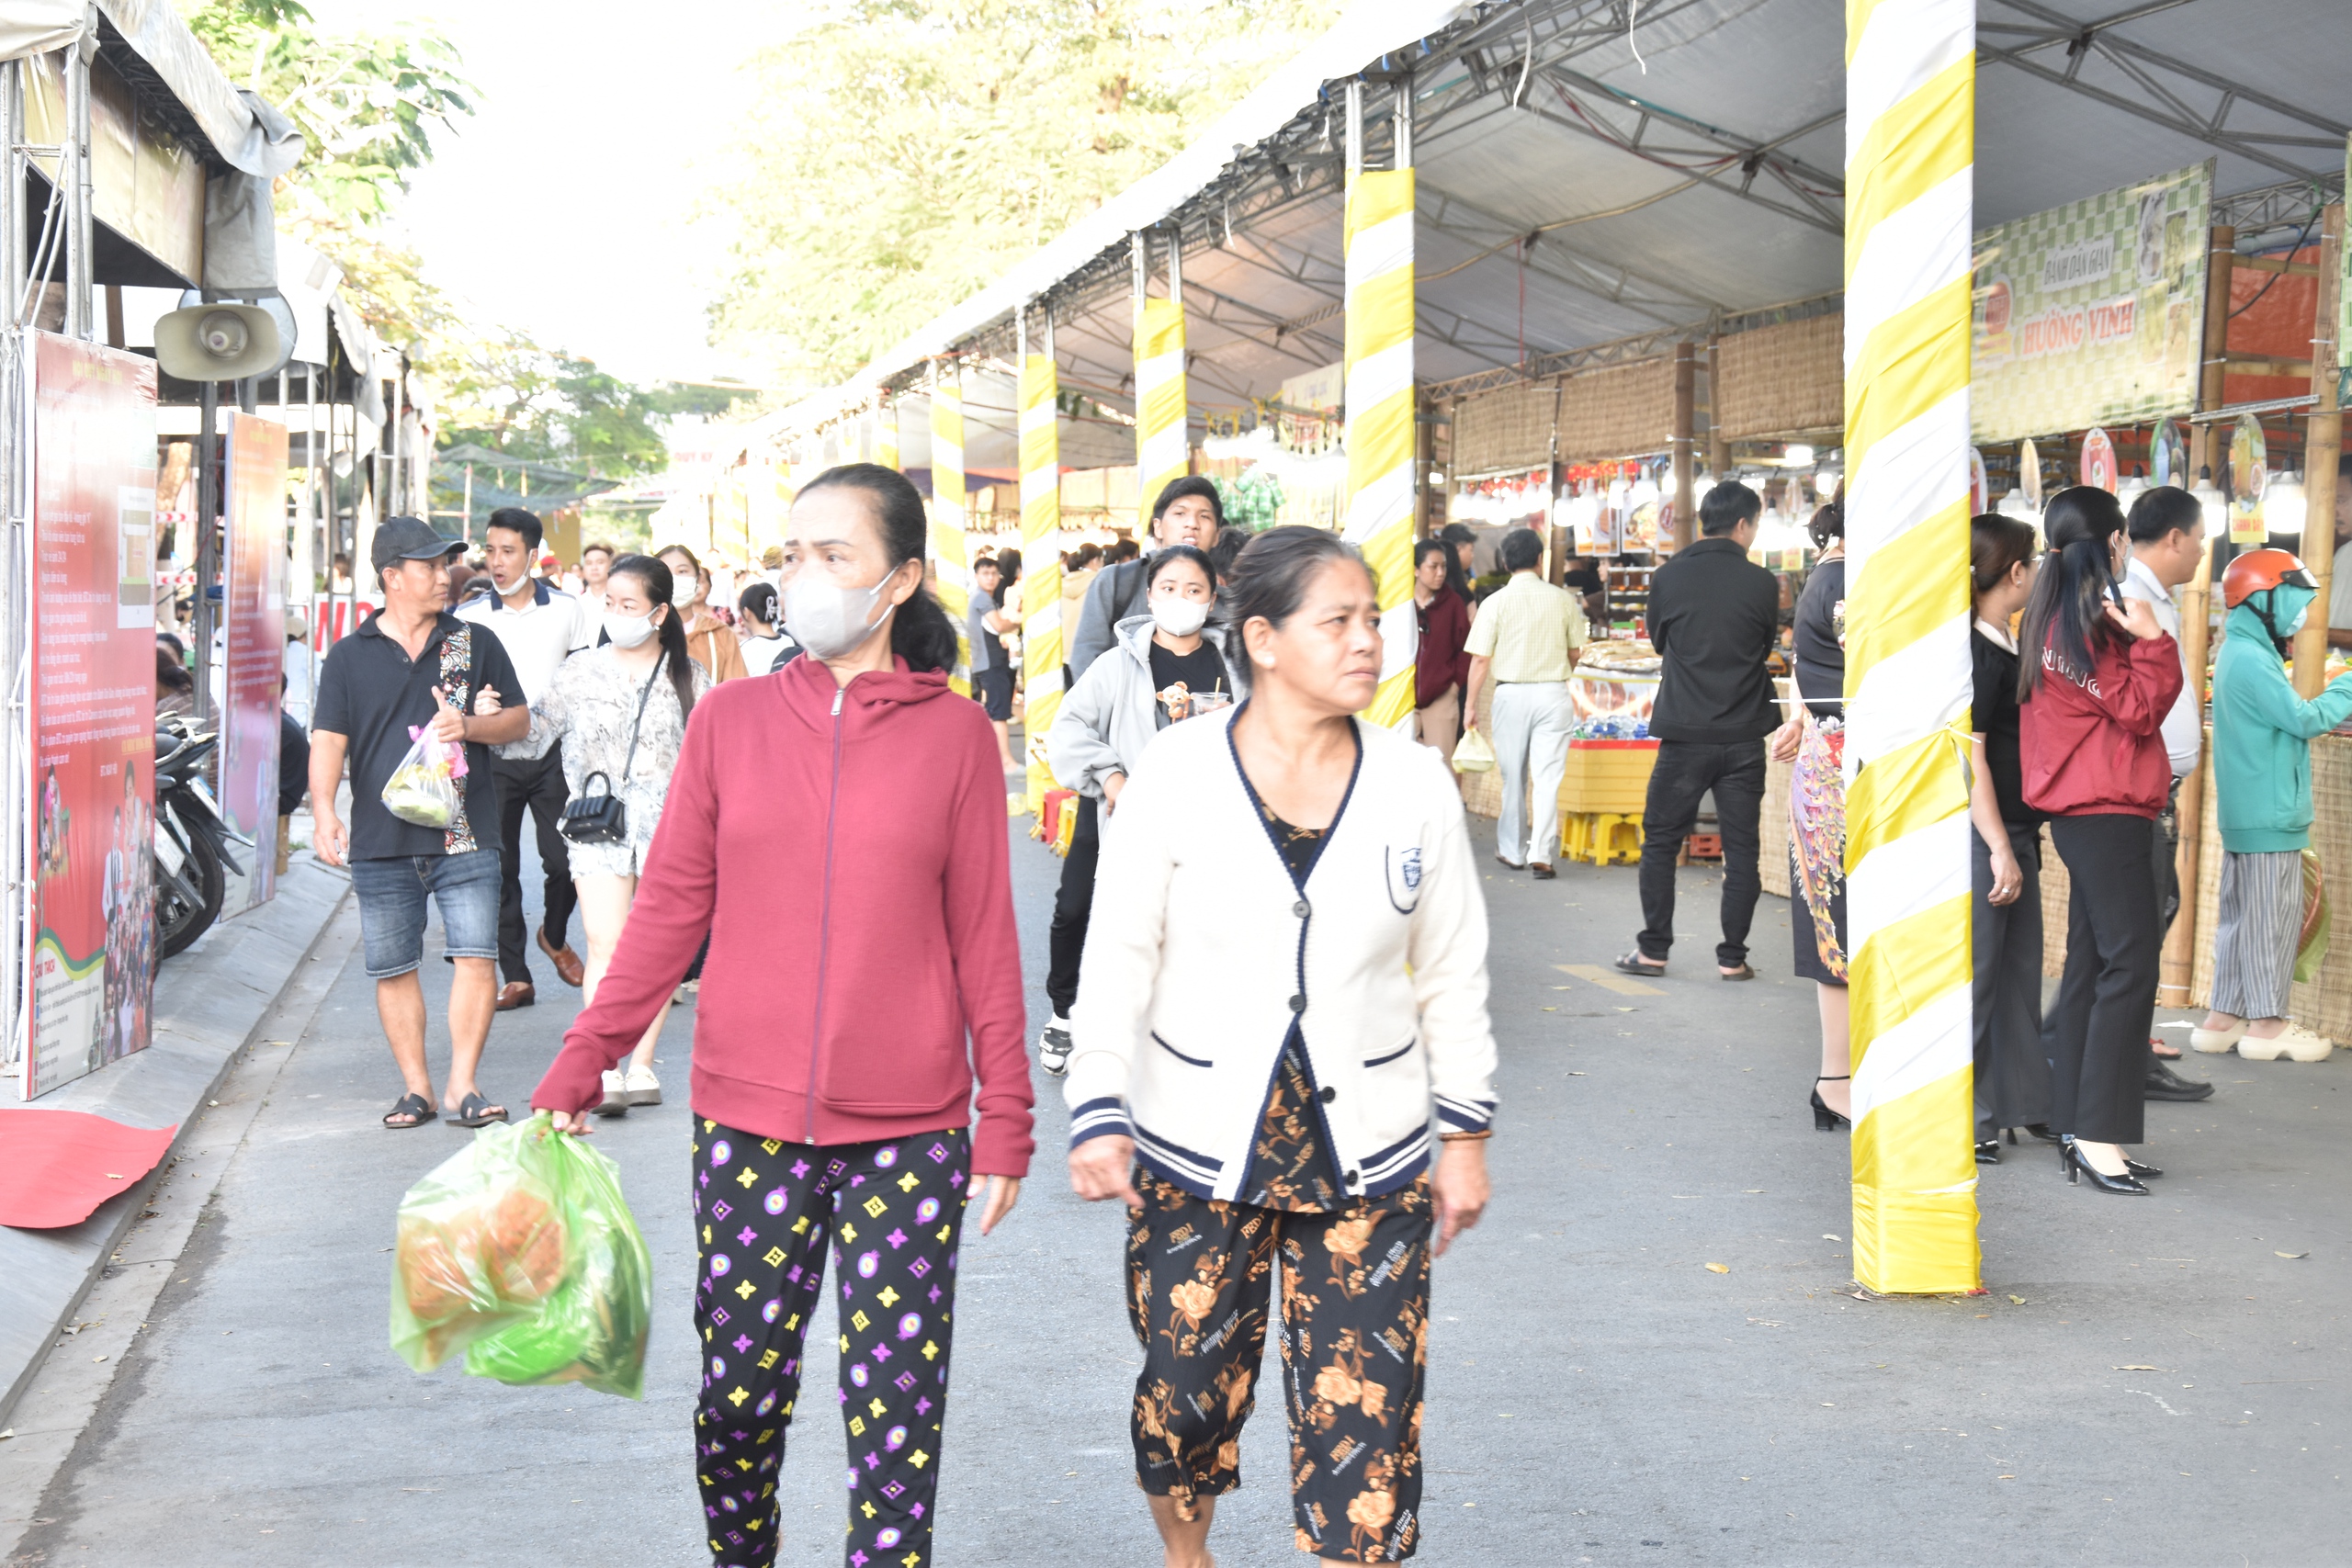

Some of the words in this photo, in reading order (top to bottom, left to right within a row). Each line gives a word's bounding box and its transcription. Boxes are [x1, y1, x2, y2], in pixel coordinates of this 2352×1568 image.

[2044, 253, 2067, 285] BÁNH
[2068, 247, 2088, 280] DÂN
[2088, 244, 2112, 275] GIAN
[2088, 300, 2135, 341] VINH
